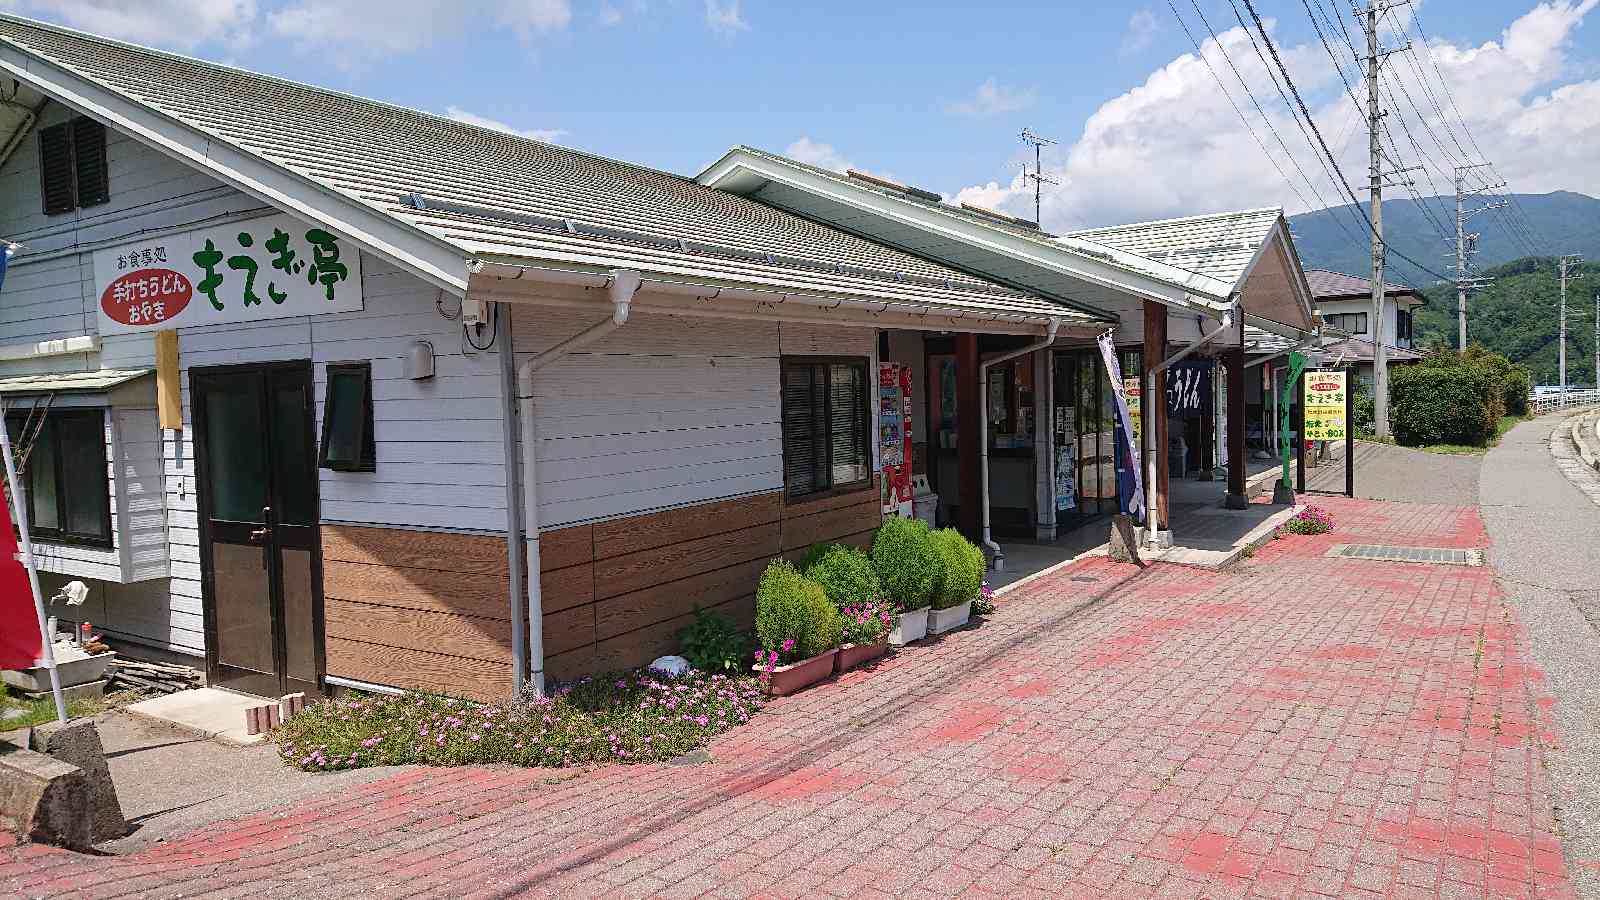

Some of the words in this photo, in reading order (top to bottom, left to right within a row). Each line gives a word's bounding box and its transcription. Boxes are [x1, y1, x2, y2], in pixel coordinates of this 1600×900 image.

[117, 246, 167, 270] お食事処
[192, 227, 348, 312] もえぎ亭
[113, 273, 186, 304] 手打ちうどん
[129, 300, 165, 323] おやき
